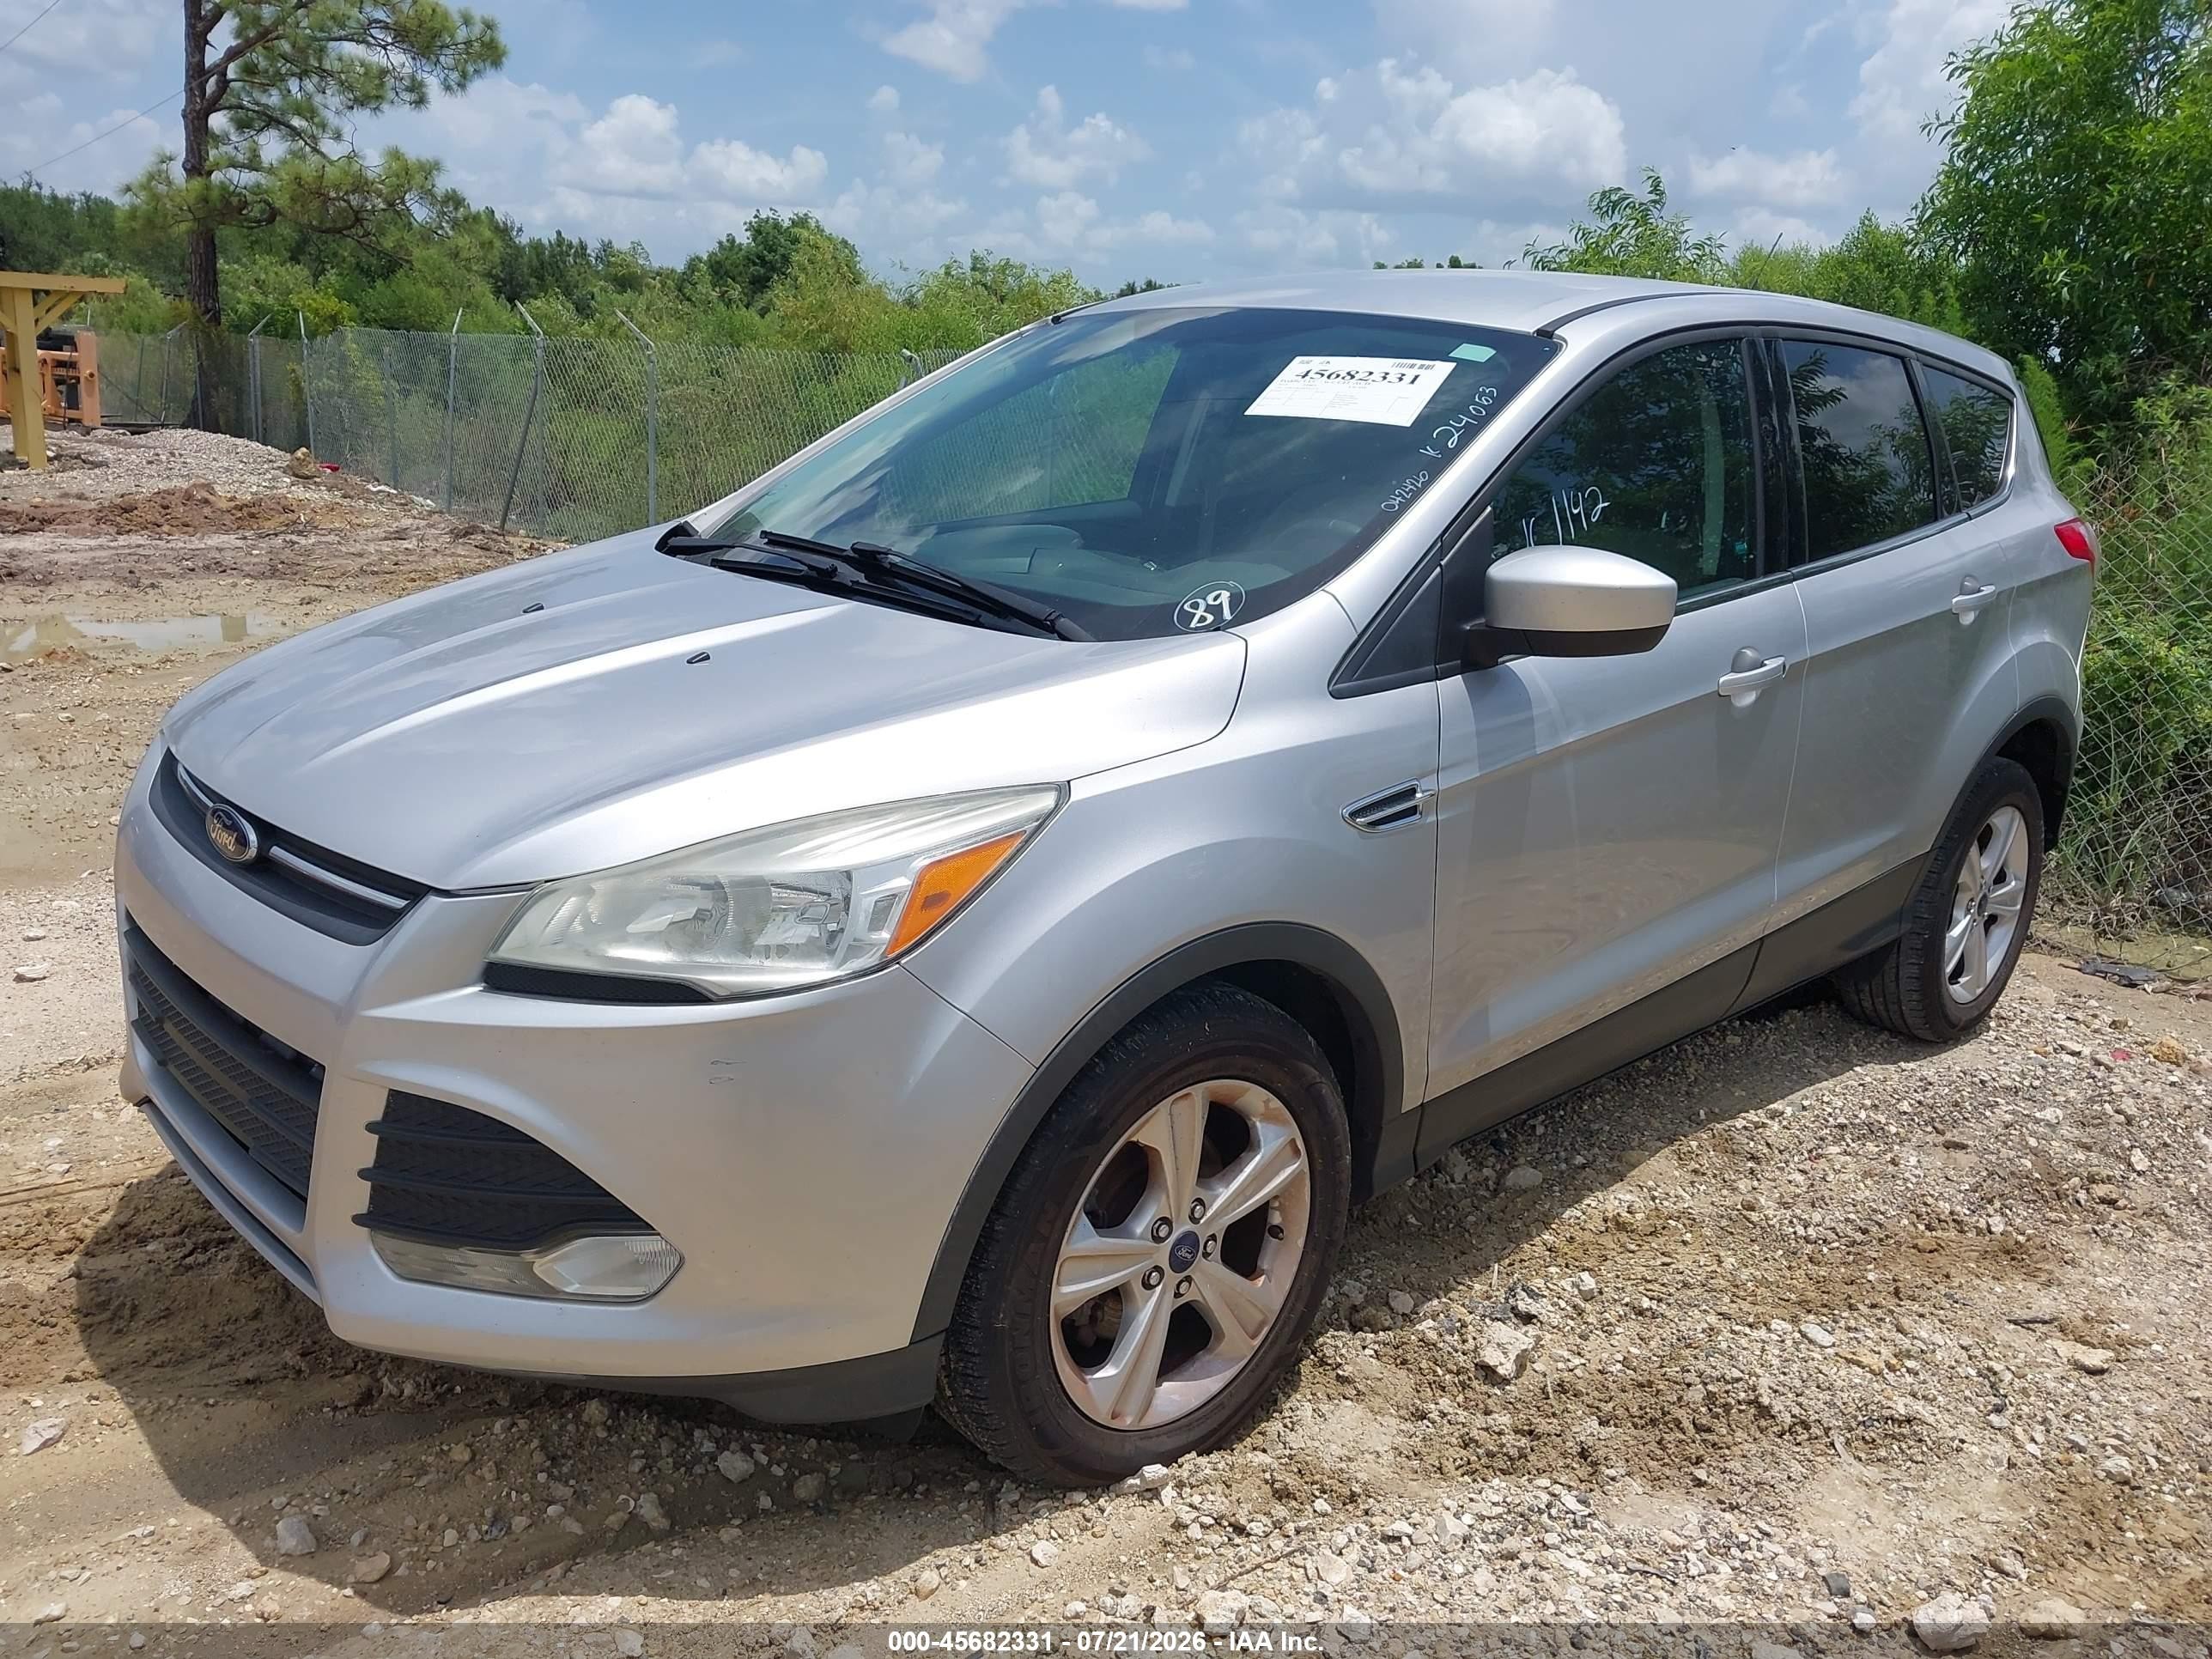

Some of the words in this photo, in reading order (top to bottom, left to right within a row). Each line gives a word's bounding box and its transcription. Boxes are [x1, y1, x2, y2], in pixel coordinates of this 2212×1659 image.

[1295, 368, 1421, 386] 45682331
[1182, 589, 1231, 628] 89
[210, 811, 239, 852] Ford
